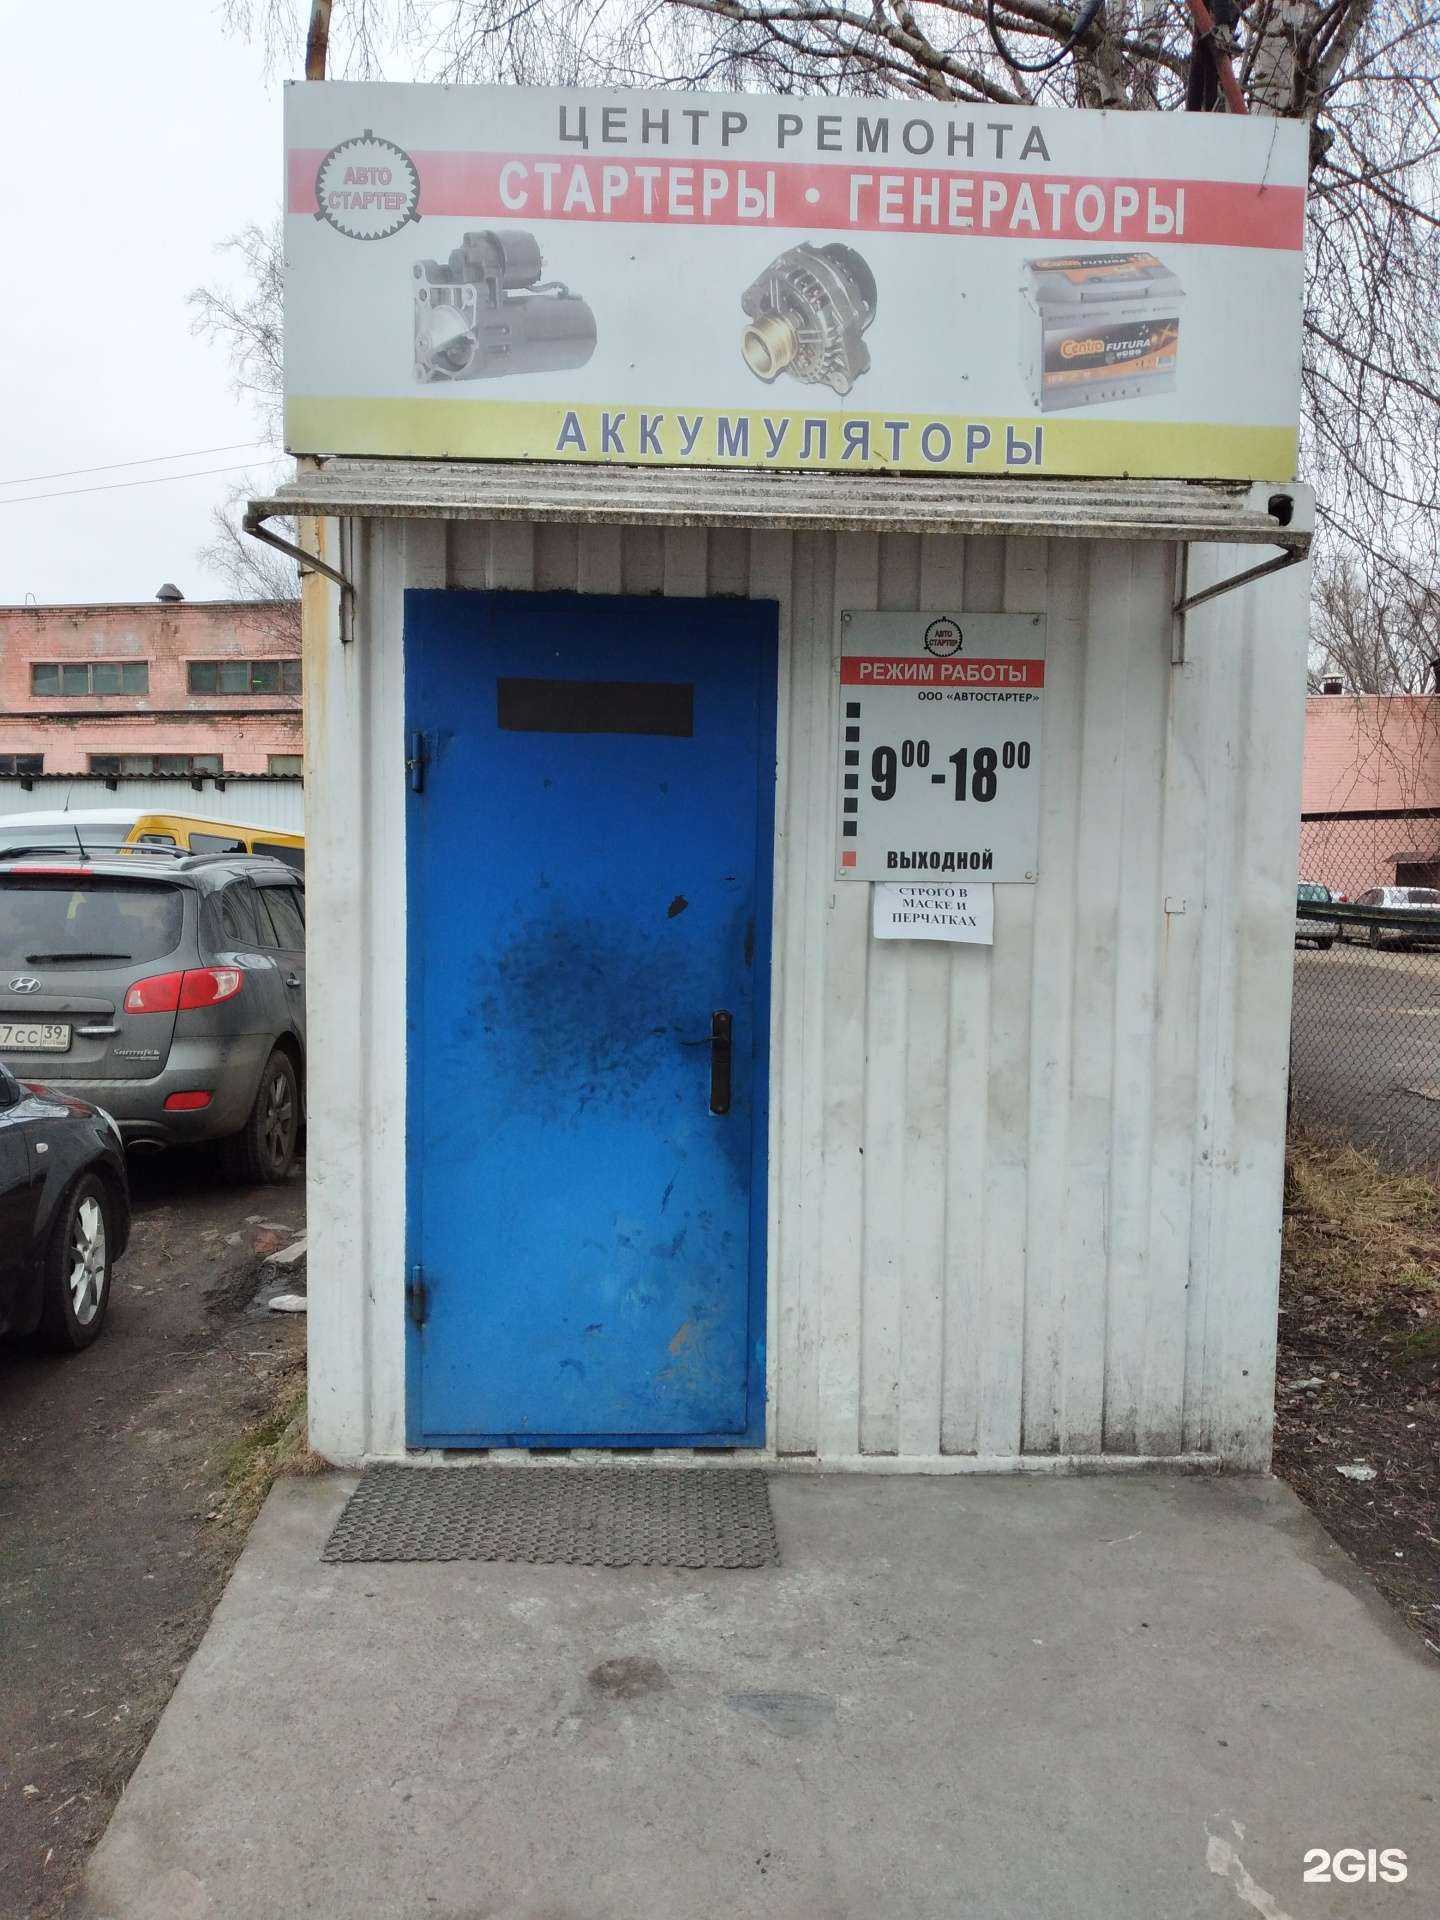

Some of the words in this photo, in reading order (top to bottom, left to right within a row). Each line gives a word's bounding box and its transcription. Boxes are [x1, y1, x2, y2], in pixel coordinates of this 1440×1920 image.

[558, 105, 748, 149] ЦЕНТР
[778, 113, 1051, 162] РЕМОНТА
[343, 166, 393, 186] АВТО
[328, 190, 408, 210] СТАРТЕР
[499, 160, 776, 219] СТАРТЕРЫ
[849, 173, 1185, 236] ГЕНЕРАТОРЫ
[1106, 338, 1151, 352] FUTURA
[555, 411, 1043, 466] АККУМУЛЯТОРЫ
[859, 662, 934, 681] РЕЖИМ
[940, 663, 1027, 682] РАБОТЫ
[917, 691, 943, 701] ООО
[946, 691, 1040, 703] «АВТОСТАРТЕР»
[887, 848, 993, 872] ВЫХОДНОЙ
[899, 887, 955, 897] СТРОГО
[959, 888, 968, 898] В
[902, 898, 953, 910] МАСКЕ
[957, 901, 967, 911] И
[892, 912, 977, 927] ПЕРЧАТКАХ
[44, 1025, 63, 1040] 39
